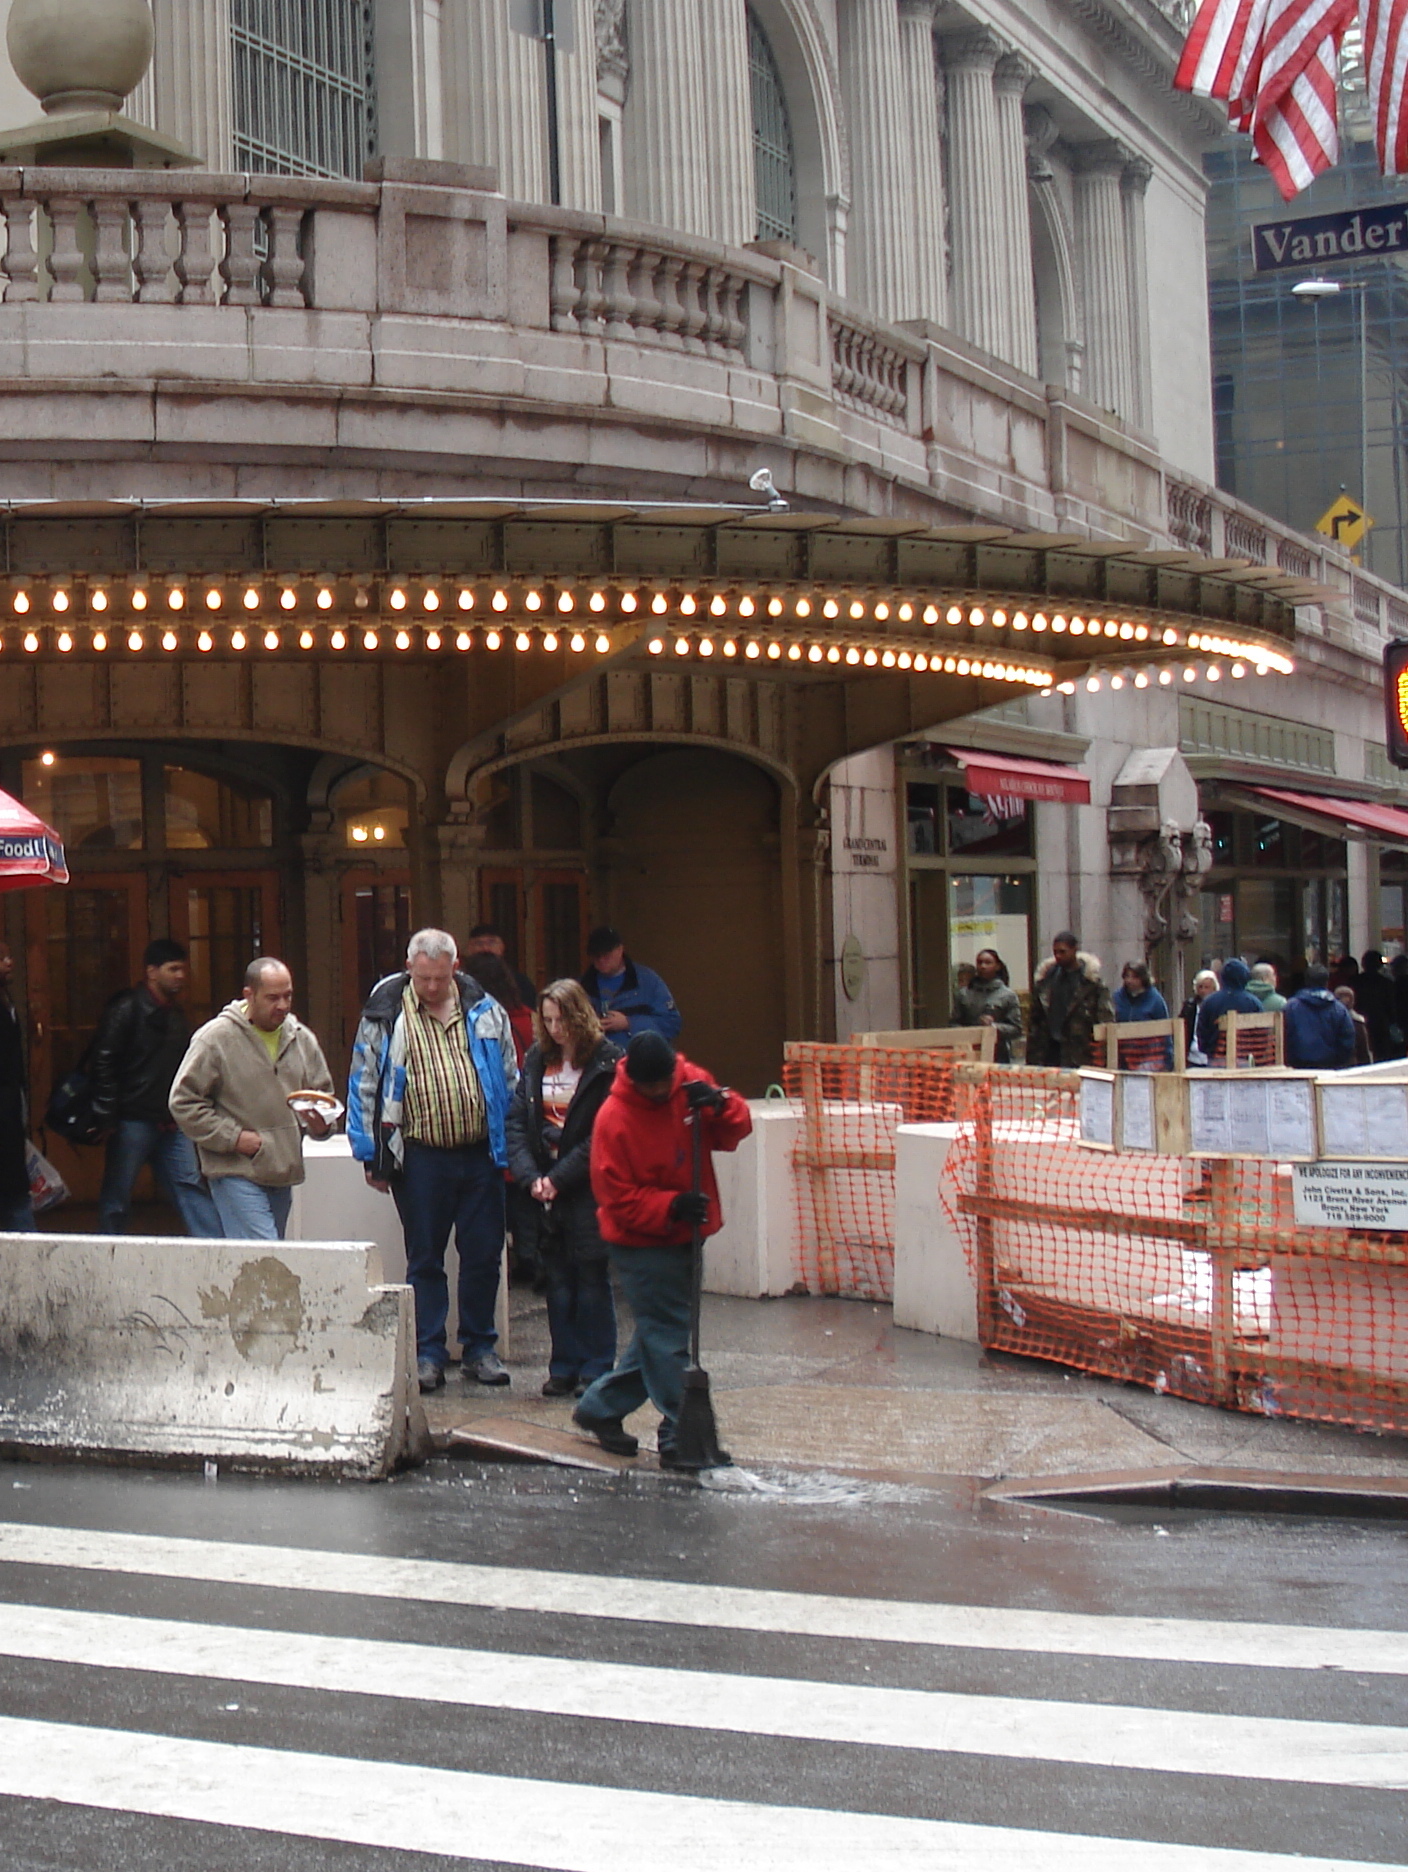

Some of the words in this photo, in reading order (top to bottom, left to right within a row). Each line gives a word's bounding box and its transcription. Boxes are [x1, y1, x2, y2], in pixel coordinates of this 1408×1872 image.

[1261, 210, 1408, 263] Vander
[1309, 1167, 1339, 1179] APOLOGIZE
[1340, 1168, 1351, 1179] FOR
[1352, 1168, 1363, 1179] ANY
[1365, 1168, 1408, 1181] INCONVENIENC
[1303, 1186, 1322, 1194] John
[1303, 1194, 1323, 1202] 1123
[1326, 1195, 1350, 1203] Bronx
[1376, 1197, 1408, 1205] Avenue
